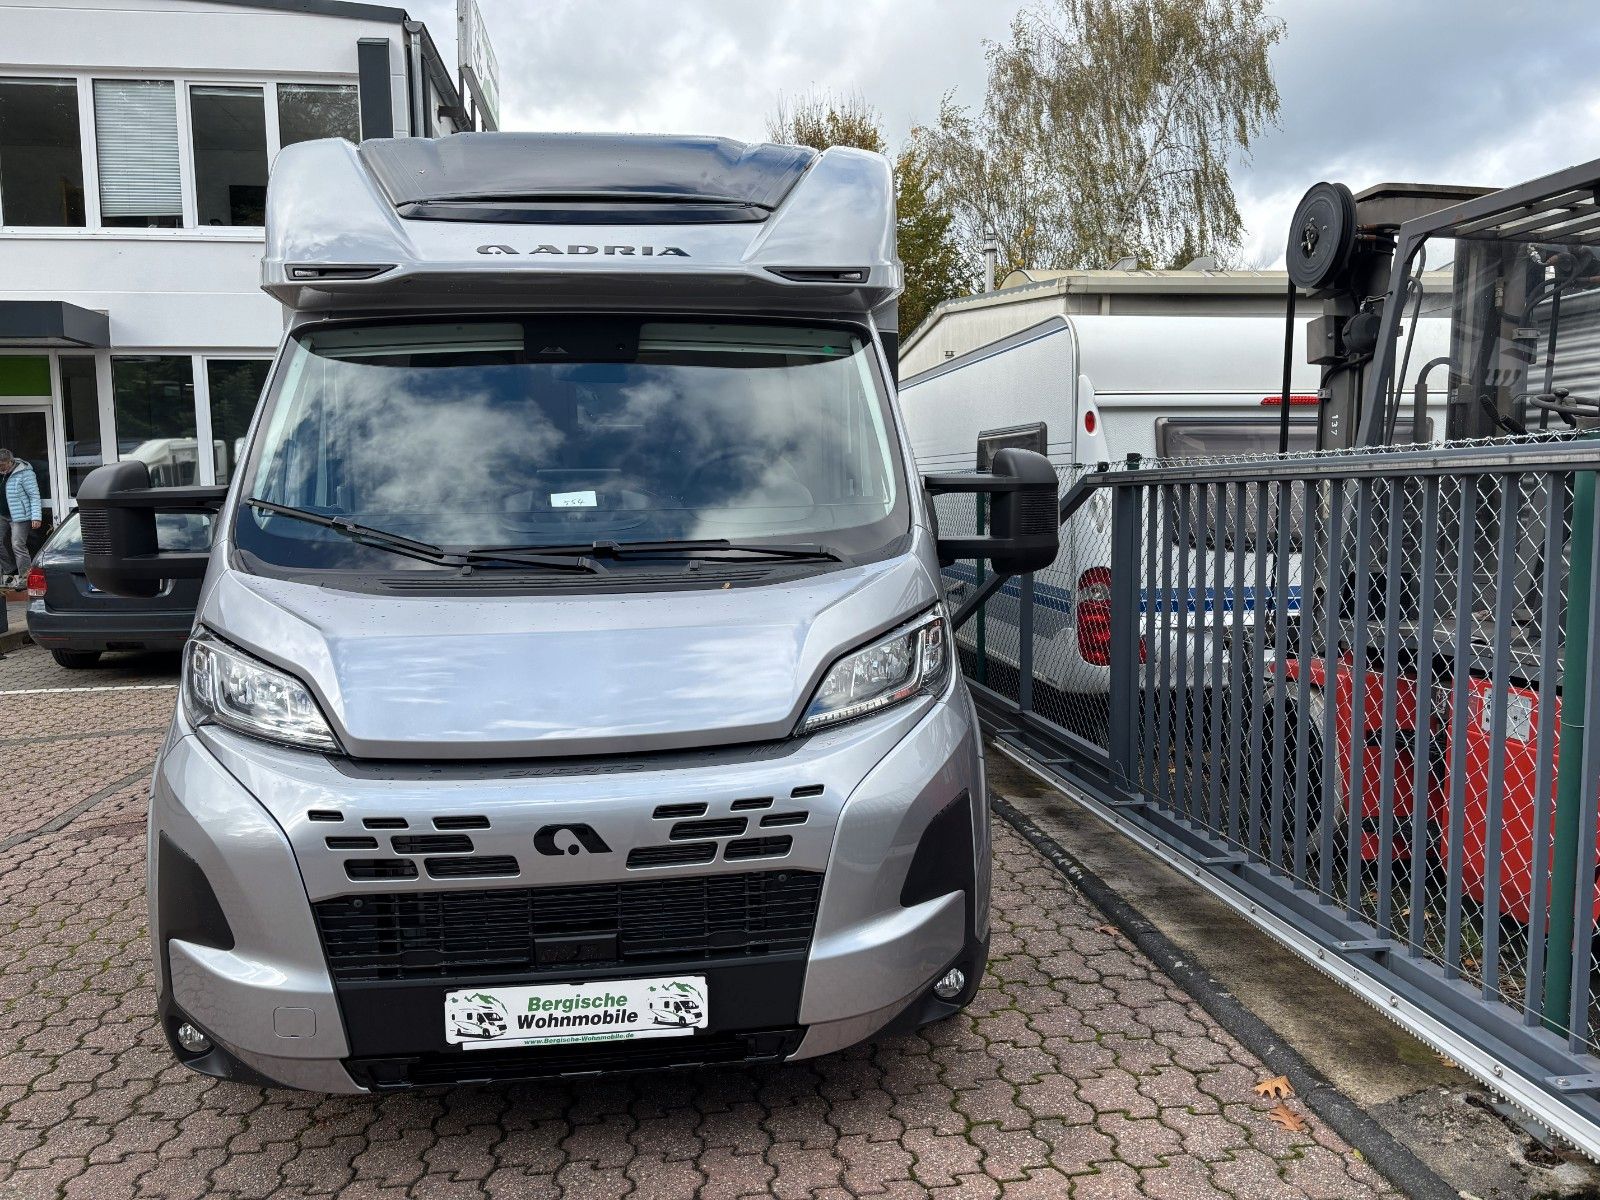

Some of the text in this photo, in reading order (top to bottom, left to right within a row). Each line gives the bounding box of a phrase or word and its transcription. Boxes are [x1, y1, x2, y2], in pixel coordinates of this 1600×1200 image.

[529, 244, 691, 257] ADRIA
[1331, 414, 1339, 436] 137
[527, 992, 628, 1013] Bergische
[517, 1008, 639, 1030] Wohnmobile
[523, 1032, 635, 1045] www.Bergische-Wohnmobile.de
